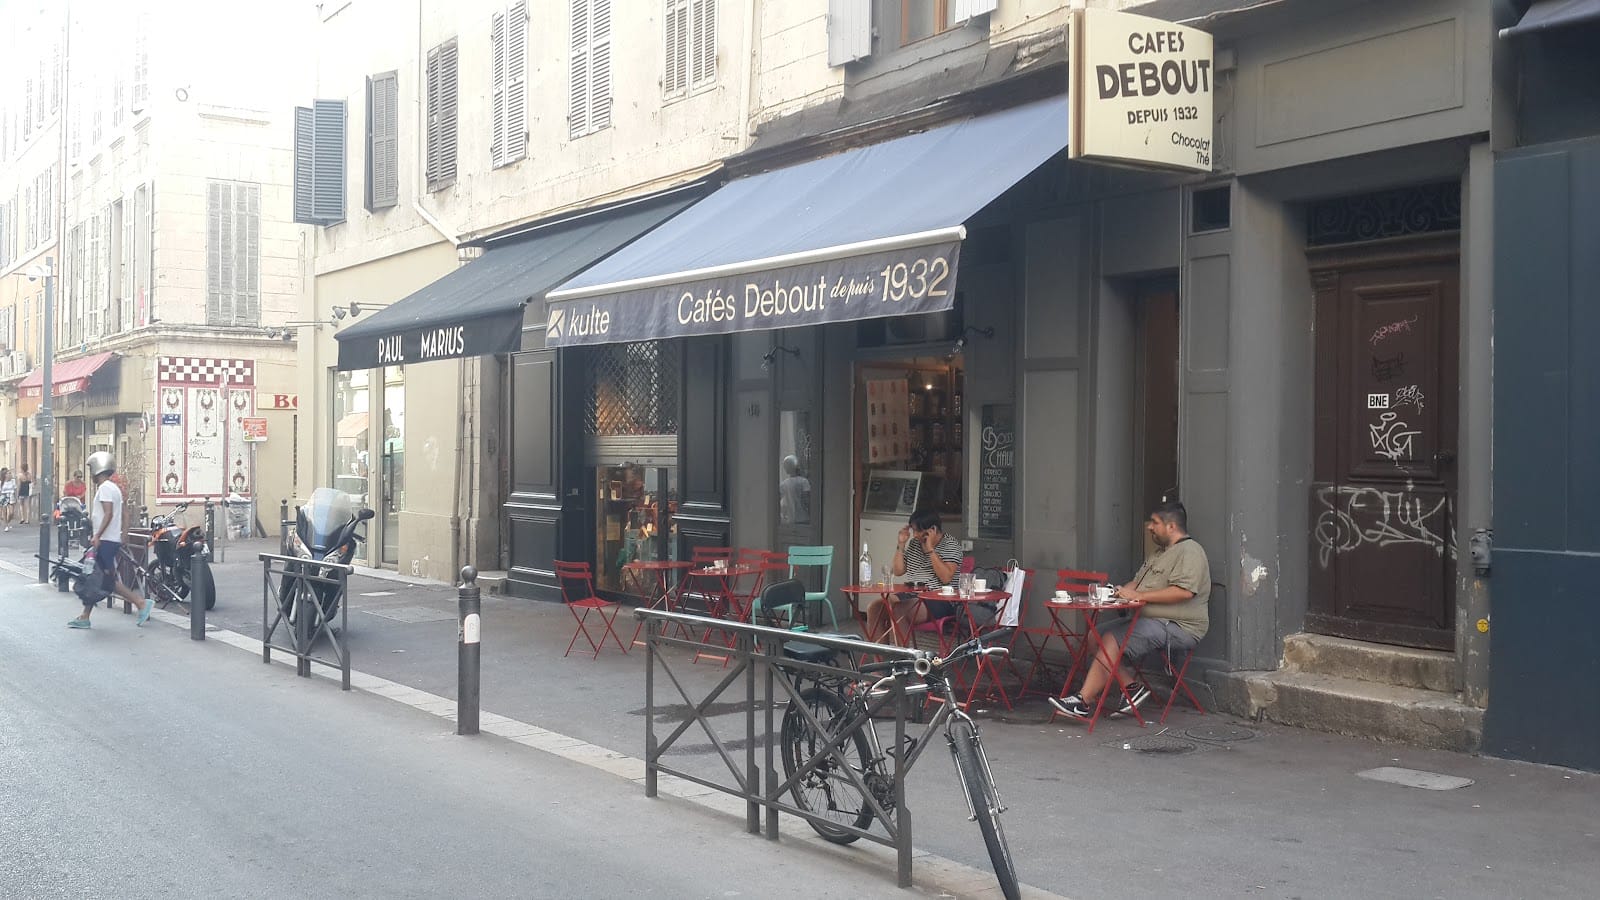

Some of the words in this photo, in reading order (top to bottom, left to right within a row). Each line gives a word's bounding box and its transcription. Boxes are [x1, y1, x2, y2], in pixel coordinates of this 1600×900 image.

[1128, 31, 1184, 55] CAFES
[1096, 59, 1211, 100] DEBOUT
[1127, 109, 1168, 125] DEPUIS
[1173, 106, 1198, 121] 1932
[1171, 131, 1211, 150] Chocolat
[1196, 150, 1210, 166] Thé
[677, 287, 736, 326] Cafés
[744, 274, 827, 319] Debout
[830, 276, 875, 305] depuis
[879, 256, 950, 303] 1932
[568, 304, 610, 337] kulte
[378, 335, 404, 364] PAUL
[420, 326, 465, 359] MARIUS
[1369, 395, 1388, 407] BNE
